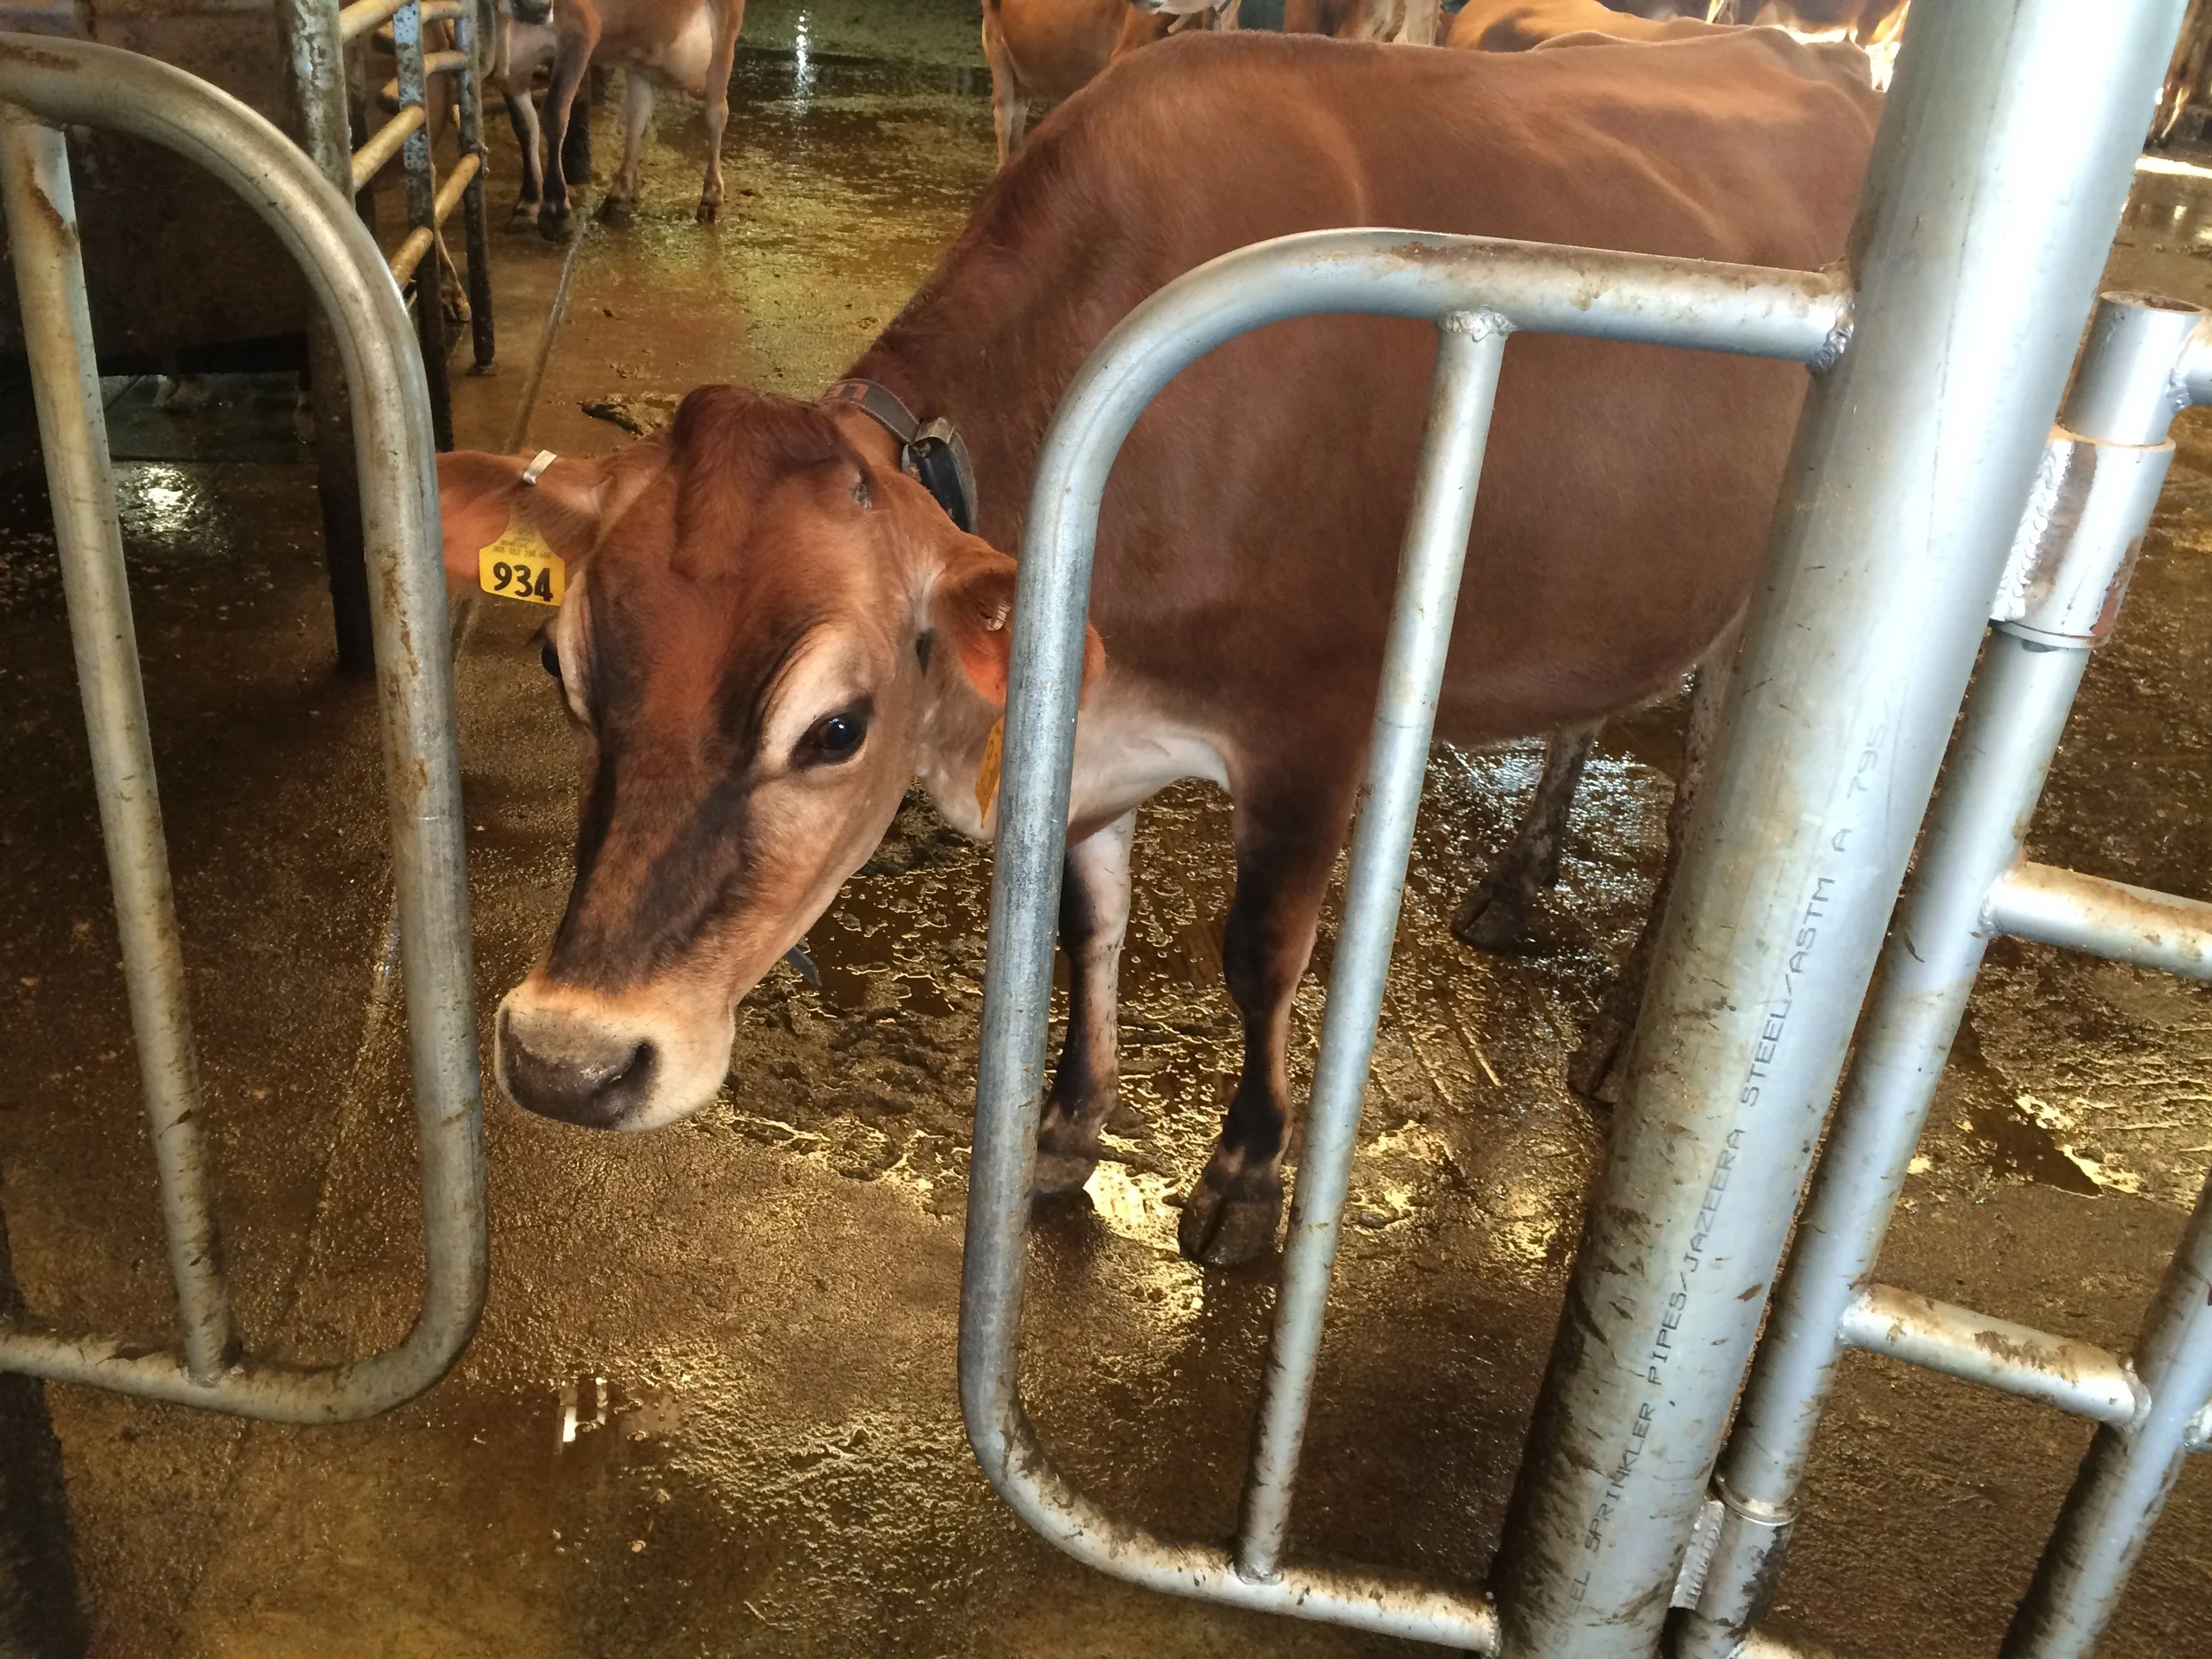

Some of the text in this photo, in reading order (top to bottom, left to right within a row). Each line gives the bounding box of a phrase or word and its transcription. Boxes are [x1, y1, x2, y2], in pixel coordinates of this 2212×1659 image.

[494, 562, 553, 602] 934
[1583, 1402, 1655, 1553] SPRINKLER
[1829, 826, 1852, 854] A
